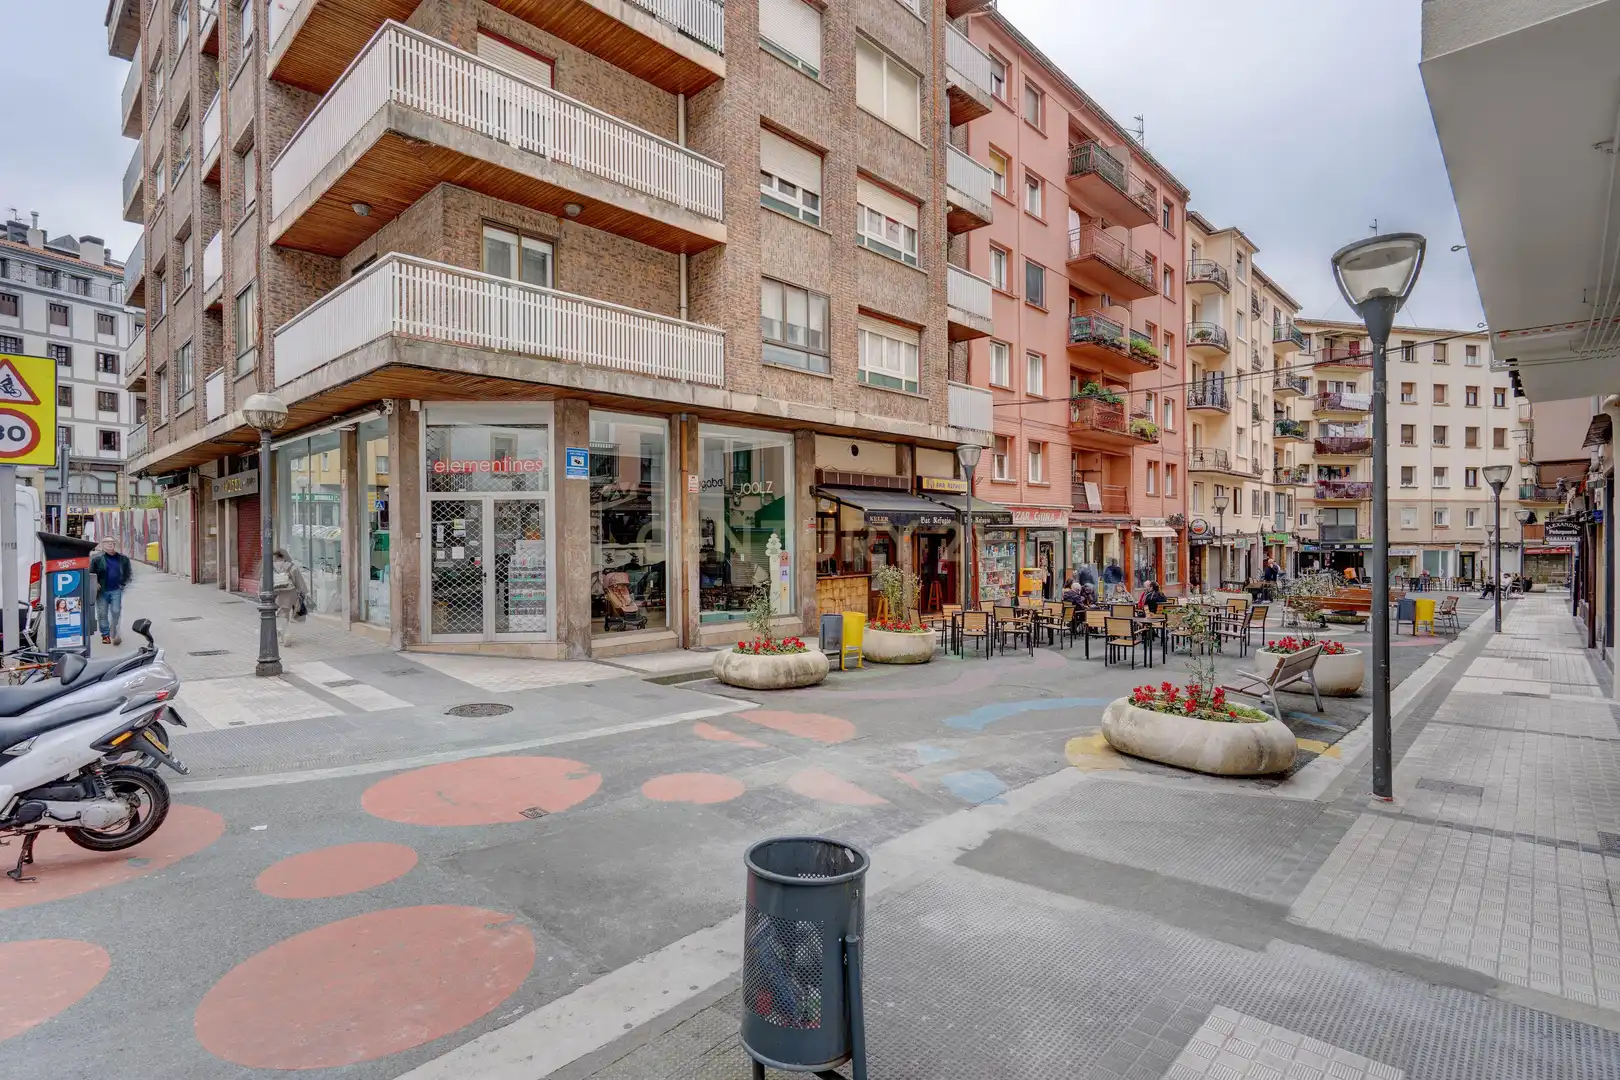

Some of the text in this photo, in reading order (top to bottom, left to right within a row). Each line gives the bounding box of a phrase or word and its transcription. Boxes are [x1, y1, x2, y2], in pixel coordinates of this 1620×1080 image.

[434, 457, 543, 473] elementines
[735, 480, 773, 495] JOOLZ
[1545, 522, 1581, 531] ALEXANDRE
[57, 573, 73, 591] P
